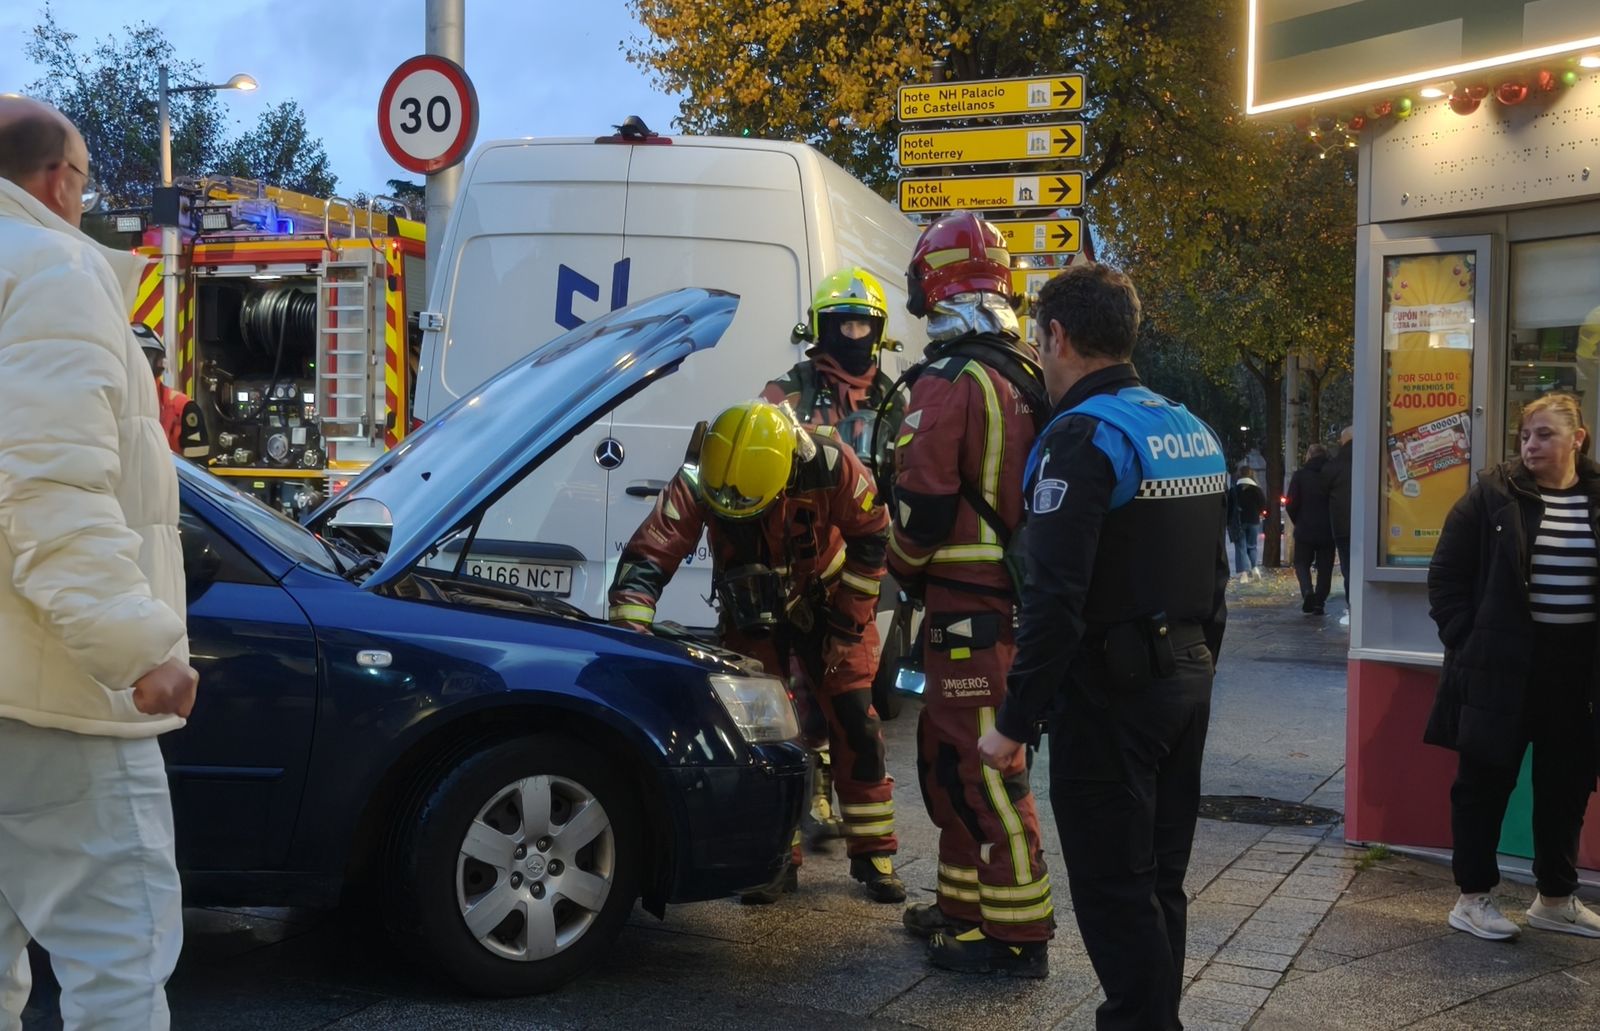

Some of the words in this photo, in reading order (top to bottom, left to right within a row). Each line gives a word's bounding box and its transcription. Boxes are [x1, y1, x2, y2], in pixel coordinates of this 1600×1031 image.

[939, 89, 957, 100] NH
[961, 86, 1005, 98] Palacio
[904, 105, 918, 115] de
[923, 101, 995, 113] Castellanos
[399, 95, 451, 135] 30
[903, 137, 934, 149] hotel
[903, 149, 963, 161] Monterrey
[908, 182, 942, 194] hotel
[907, 196, 951, 208] IKONIK
[970, 196, 1008, 206] Mercado
[1398, 374, 1415, 383] POR
[1418, 373, 1442, 382] SOLO
[472, 565, 520, 585] 8166
[527, 568, 565, 590] NCT
[943, 677, 989, 690] OMBEROS
